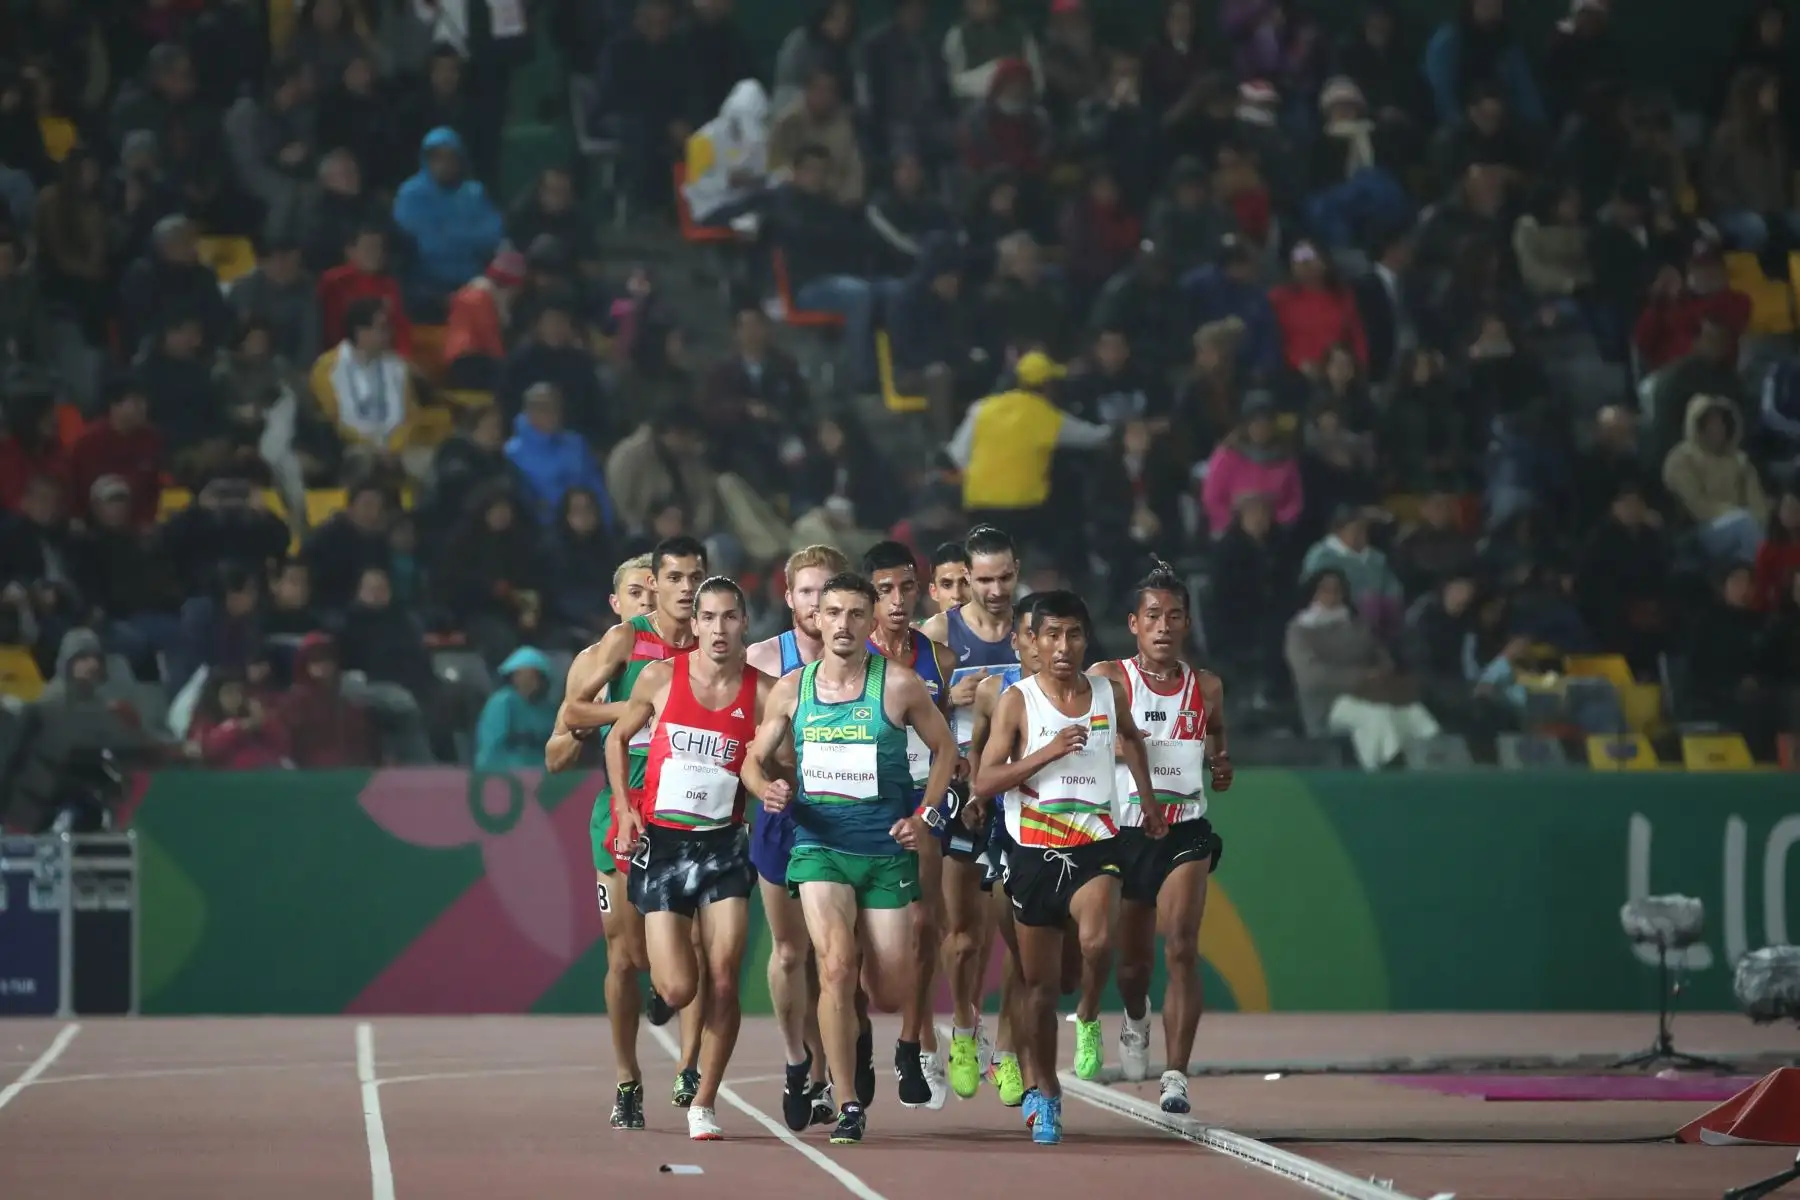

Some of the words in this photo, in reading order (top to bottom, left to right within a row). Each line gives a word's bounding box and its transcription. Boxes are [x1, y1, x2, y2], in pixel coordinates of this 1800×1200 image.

[1145, 711, 1167, 722] PERU
[802, 725, 873, 742] BRASIL
[671, 730, 739, 761] CHILE
[803, 769, 833, 780] VILELA
[835, 772, 875, 781] PEREIRA
[1153, 767, 1182, 776] ROJAS
[1060, 776, 1097, 785] TOROYA
[686, 791, 708, 800] DIAZ
